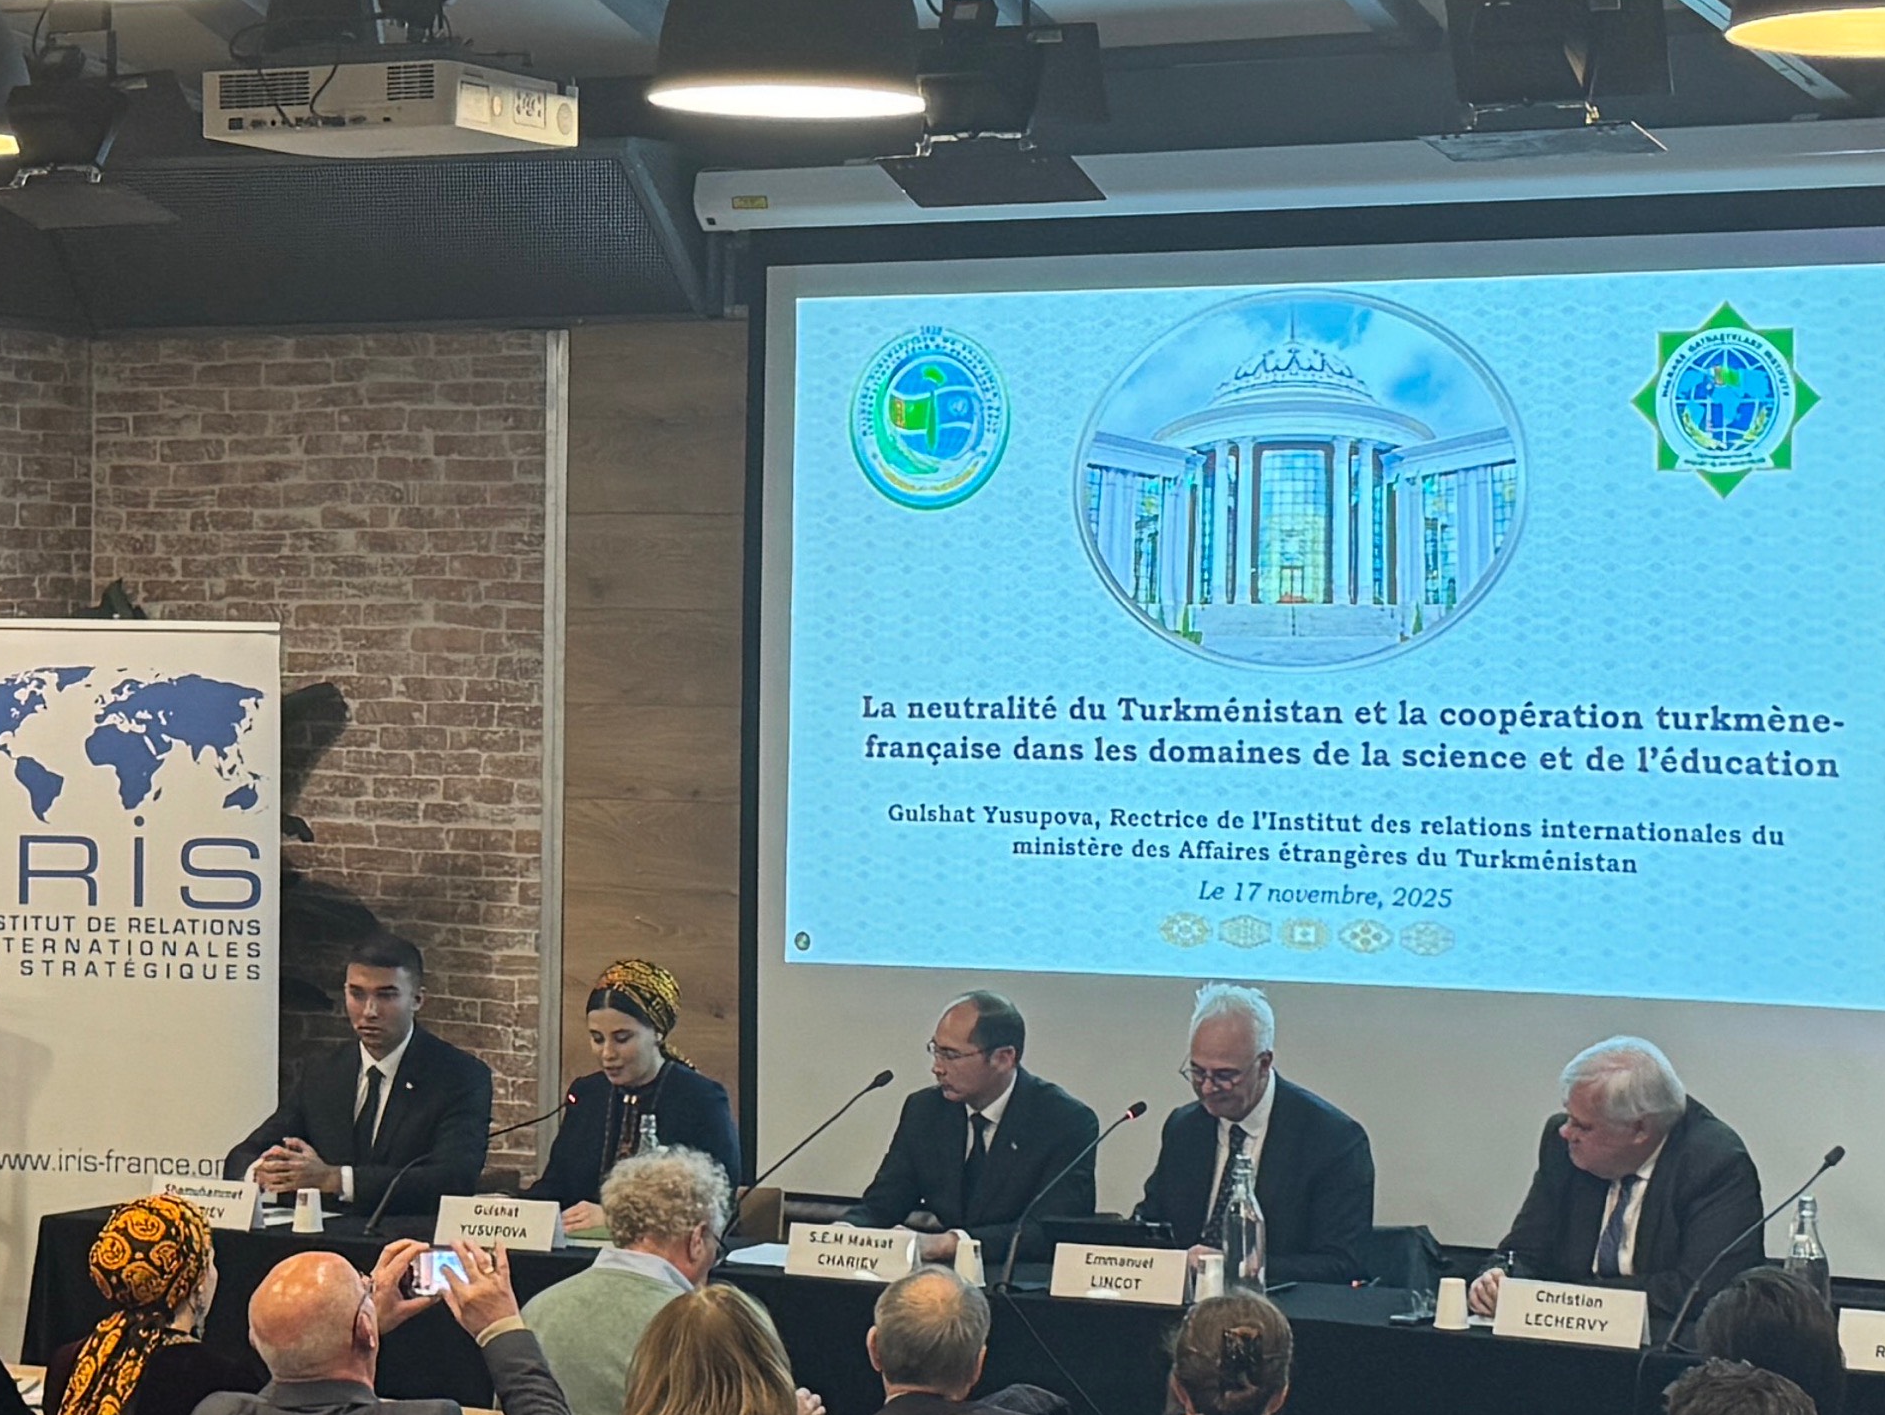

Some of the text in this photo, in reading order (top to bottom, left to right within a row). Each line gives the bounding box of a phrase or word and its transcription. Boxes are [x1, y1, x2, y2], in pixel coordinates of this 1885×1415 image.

[862, 694, 1845, 735] La neutralité du Turkménistan et la coopération turkmène-
[864, 734, 1002, 766] française
[1013, 736, 1084, 762] dans
[1094, 737, 1138, 763] les
[1148, 738, 1302, 766] domaines
[1313, 739, 1350, 766] de
[1360, 741, 1390, 767] la
[1402, 742, 1527, 771] science
[1539, 747, 1573, 771] et
[1586, 746, 1625, 772] de
[888, 803, 976, 825] Gulshat
[983, 805, 1102, 830] Yusupova,
[1110, 807, 1209, 829] Rectrice
[1217, 809, 1245, 830] de
[1370, 813, 1412, 835] des
[1420, 813, 1533, 839] relations
[1541, 817, 1742, 846] internationales
[1752, 823, 1785, 846] du
[1012, 837, 1638, 874] ministère des Affaires étrangères du Turkménistan
[1198, 880, 1453, 910] Le 17 novembre, 2025
[88, 916, 116, 933] DE
[128, 917, 261, 937] RELATIONS
[20, 959, 261, 980] STRATÉGIQUES
[460, 1224, 527, 1238] YUSUPOVA
[1085, 1252, 1154, 1269] Emmanuel
[1090, 1275, 1142, 1290] LINCOT
[1536, 1289, 1603, 1308] Christian
[1525, 1313, 1609, 1332] LECHERVY
